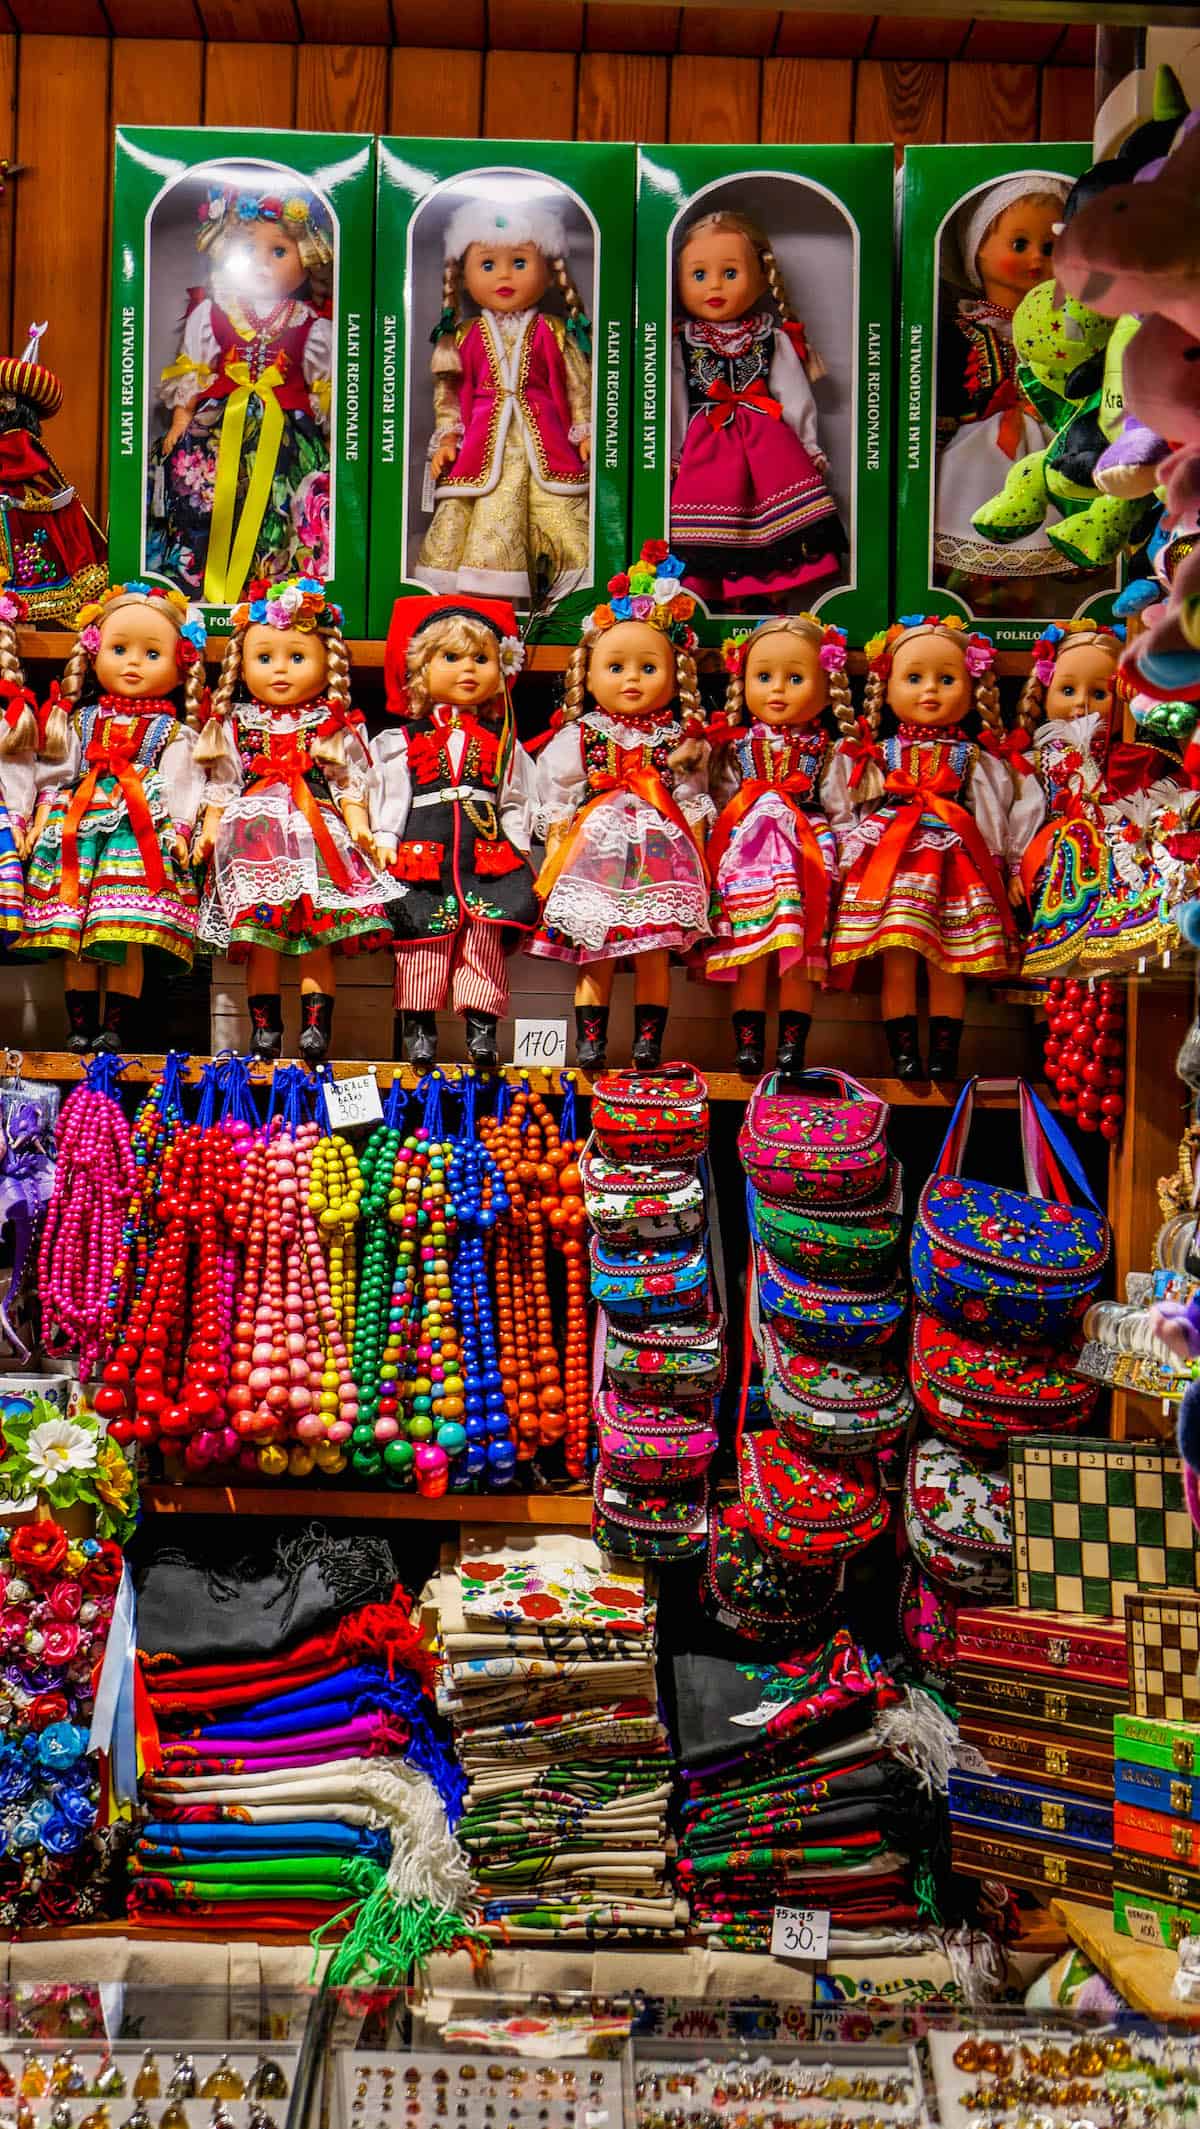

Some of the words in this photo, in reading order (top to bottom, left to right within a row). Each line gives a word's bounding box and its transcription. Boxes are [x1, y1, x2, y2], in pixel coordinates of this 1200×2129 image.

[121, 306, 135, 406] REGIONALNE
[347, 313, 361, 357] LALKI
[607, 321, 621, 364] LALKI
[868, 322, 881, 366] LALKI
[383, 314, 397, 414] REGIONALNE
[644, 321, 657, 420] REGIONALNE
[908, 324, 922, 421] REGIONALNE
[346, 362, 360, 461] REGIONALNE
[606, 370, 620, 468] REGIONALNE
[1104, 387, 1124, 409] Kra
[121, 411, 134, 456] LALKI
[382, 419, 395, 463] LALKI
[867, 372, 881, 470] REGIONALNE
[643, 425, 656, 469] LALKI
[907, 426, 921, 469] LALKI
[996, 630, 1042, 640] FOLKLO
